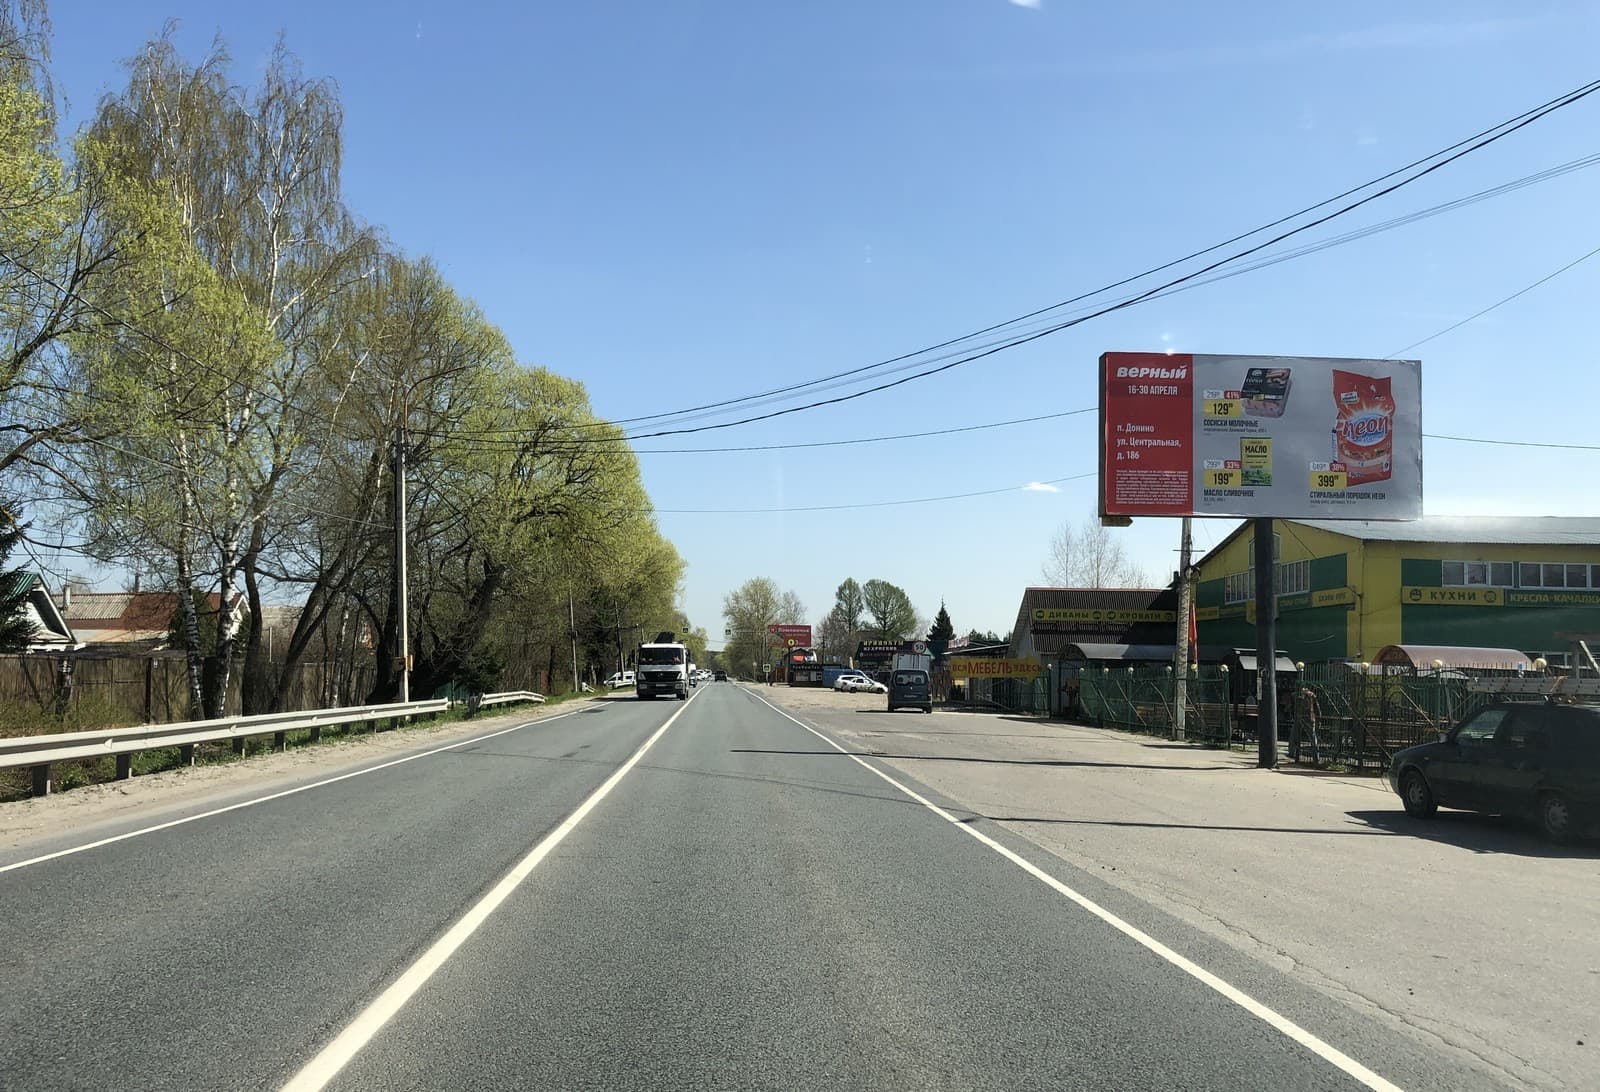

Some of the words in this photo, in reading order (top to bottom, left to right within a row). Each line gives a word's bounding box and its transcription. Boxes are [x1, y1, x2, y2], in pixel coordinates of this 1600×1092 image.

[1127, 385, 1149, 394] 16-30
[1149, 385, 1178, 395] АПРЕЛЯ
[1116, 424, 1124, 432] п.
[1125, 423, 1155, 433] Донино
[1116, 438, 1128, 447] ул.
[1129, 437, 1182, 448] Центральная,
[1245, 445, 1267, 454] МАСЛО
[1116, 452, 1124, 460] д.
[1203, 489, 1223, 497] МАСЛО
[1223, 489, 1254, 497] СЛИВОЧНОЕ
[1309, 490, 1345, 499] СТИРАЛЬНЫЙ
[1430, 592, 1477, 601] КУХНИ
[1048, 611, 1089, 619] ДИВАНЫ
[967, 661, 1012, 675] МЕБЕЛЬ
